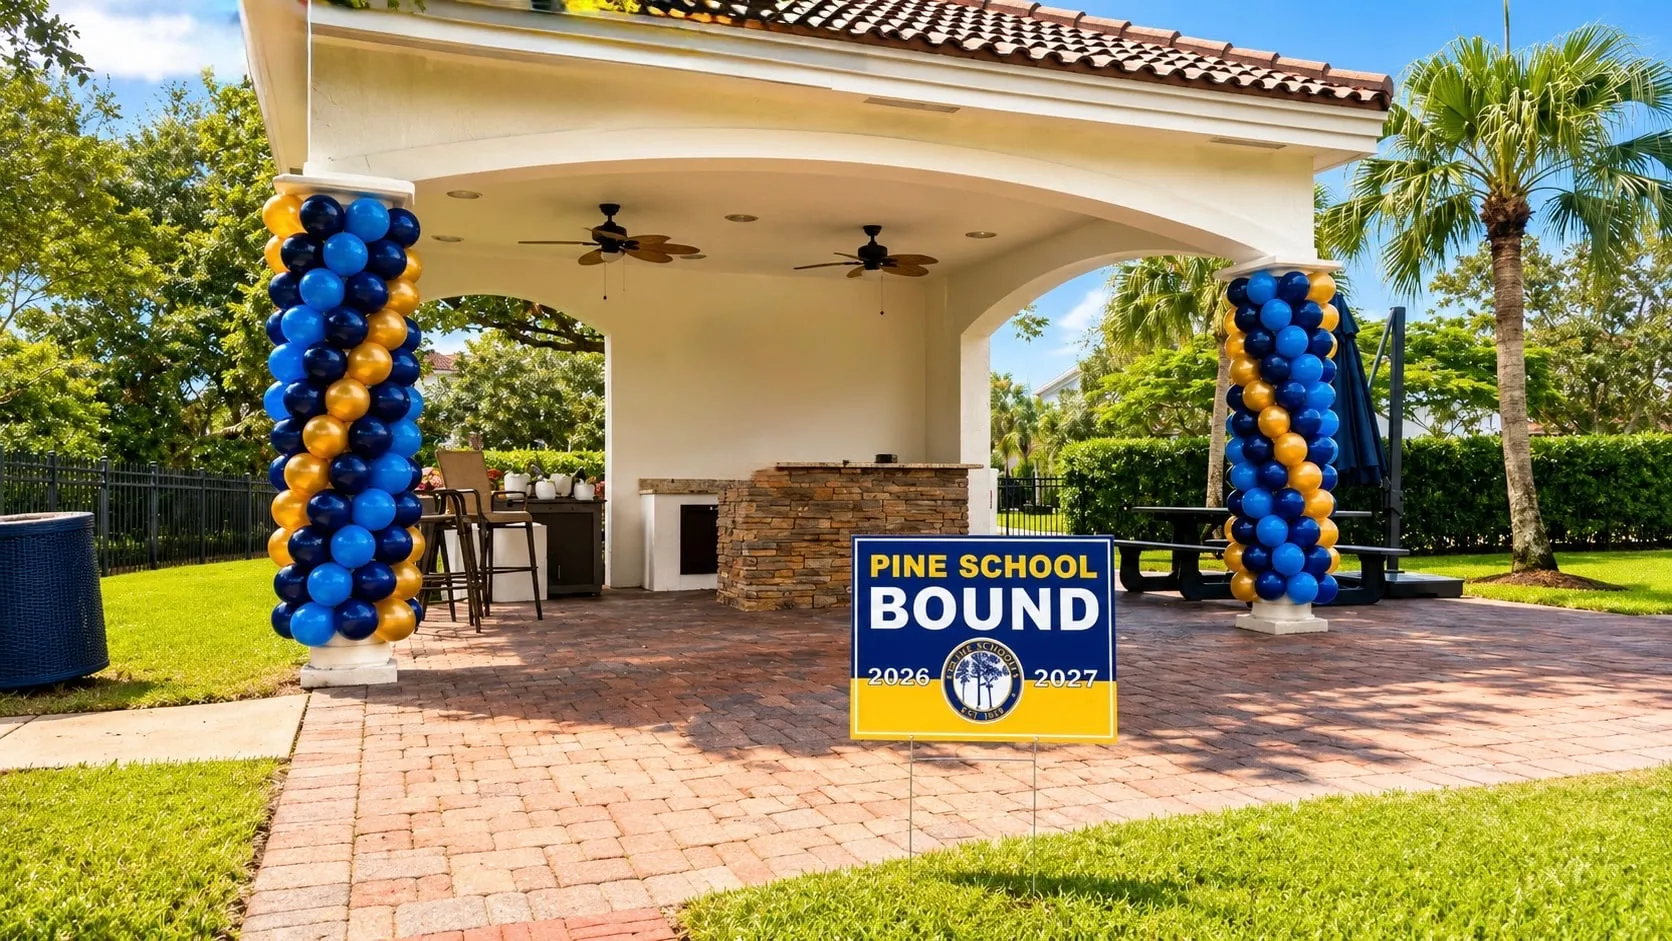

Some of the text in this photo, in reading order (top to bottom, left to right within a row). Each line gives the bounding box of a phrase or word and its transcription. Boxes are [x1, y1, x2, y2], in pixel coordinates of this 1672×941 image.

[870, 554, 1098, 579] PINE SCHOOL
[870, 586, 1099, 631] BOUND
[867, 667, 1098, 688] 2026 2027
